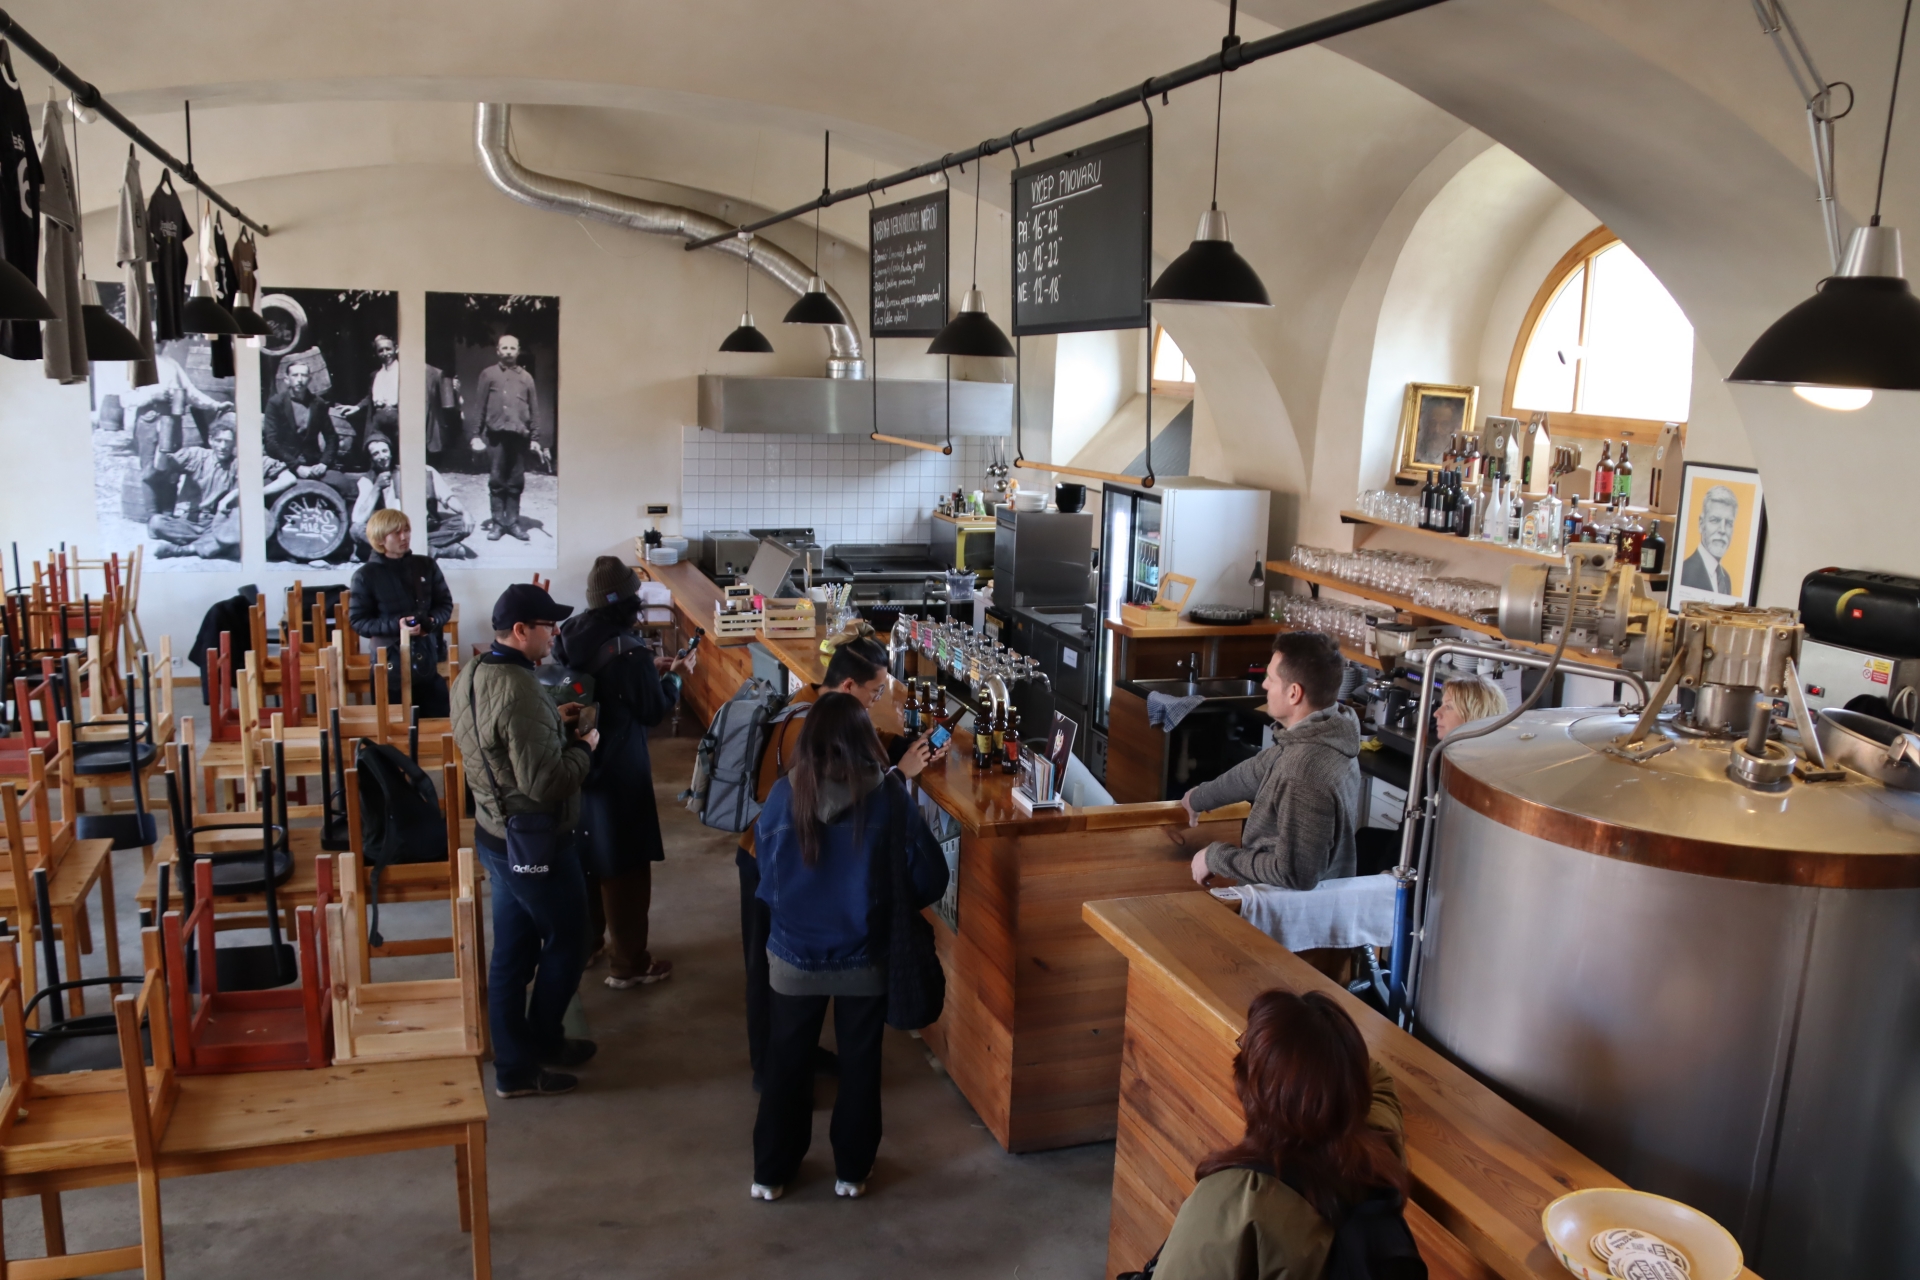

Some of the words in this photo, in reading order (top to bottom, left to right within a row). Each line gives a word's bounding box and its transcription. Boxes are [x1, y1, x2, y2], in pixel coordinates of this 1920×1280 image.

[1031, 174, 1054, 203] VÝČEP
[1059, 159, 1102, 196] PIVOVARU
[512, 864, 549, 873] adidas
